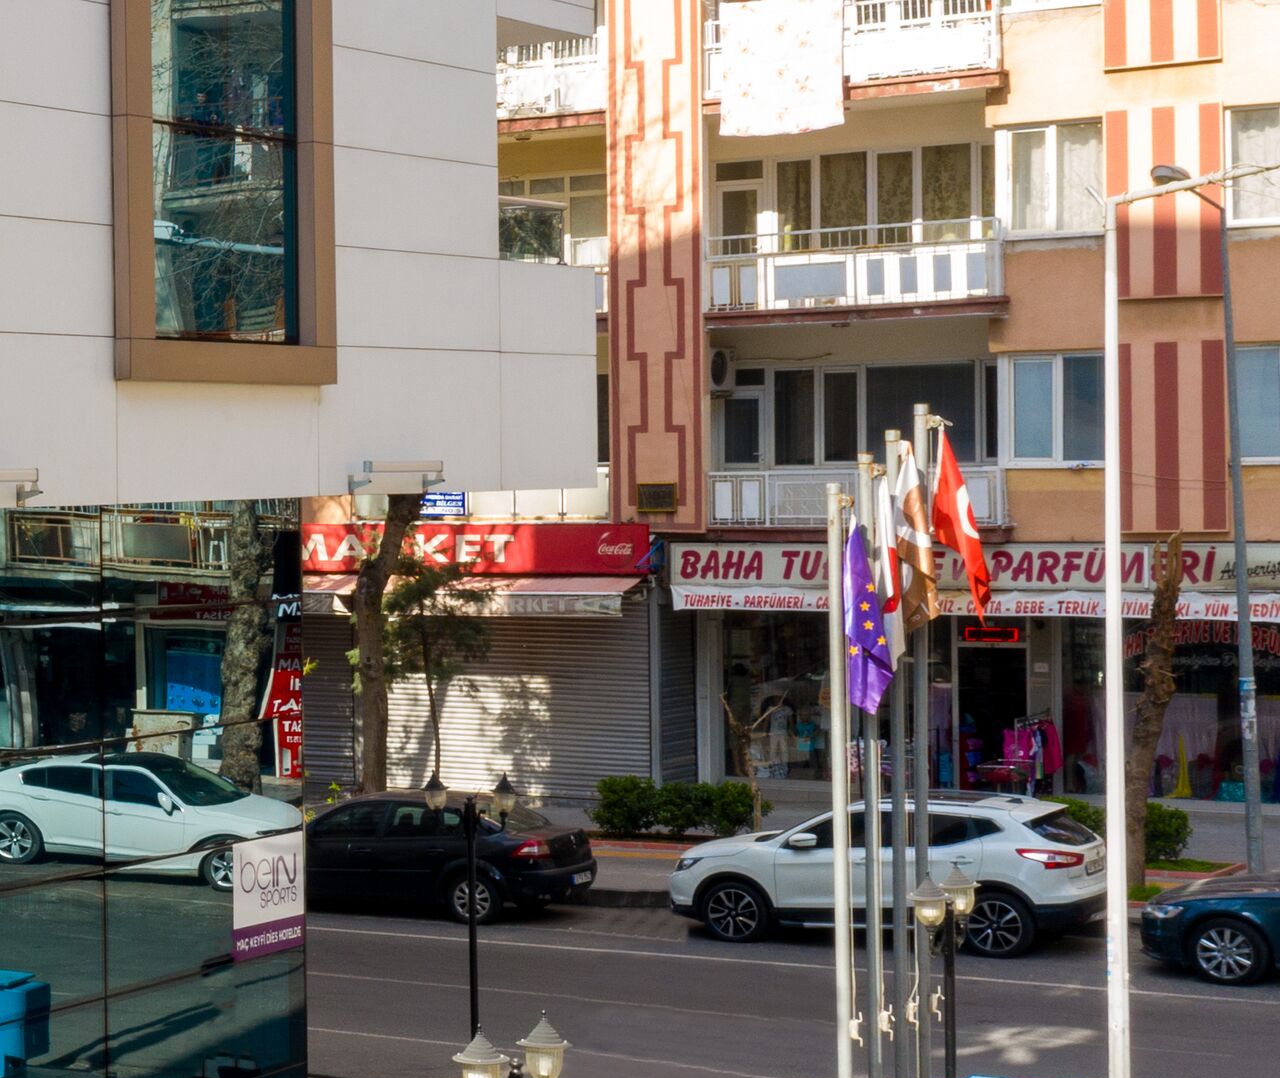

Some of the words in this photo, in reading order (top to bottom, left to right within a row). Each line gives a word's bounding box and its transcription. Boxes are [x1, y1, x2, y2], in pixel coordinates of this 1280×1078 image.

[302, 532, 515, 564] MAKET
[680, 550, 763, 580] BAHA
[683, 592, 732, 608] TUHAFİYE
[743, 592, 805, 610] PARFÜMERİ
[1015, 600, 1045, 614] BEBE
[1057, 597, 1100, 614] TERLİK
[1204, 599, 1230, 617] YÜN
[260, 885, 297, 909] SPORTS
